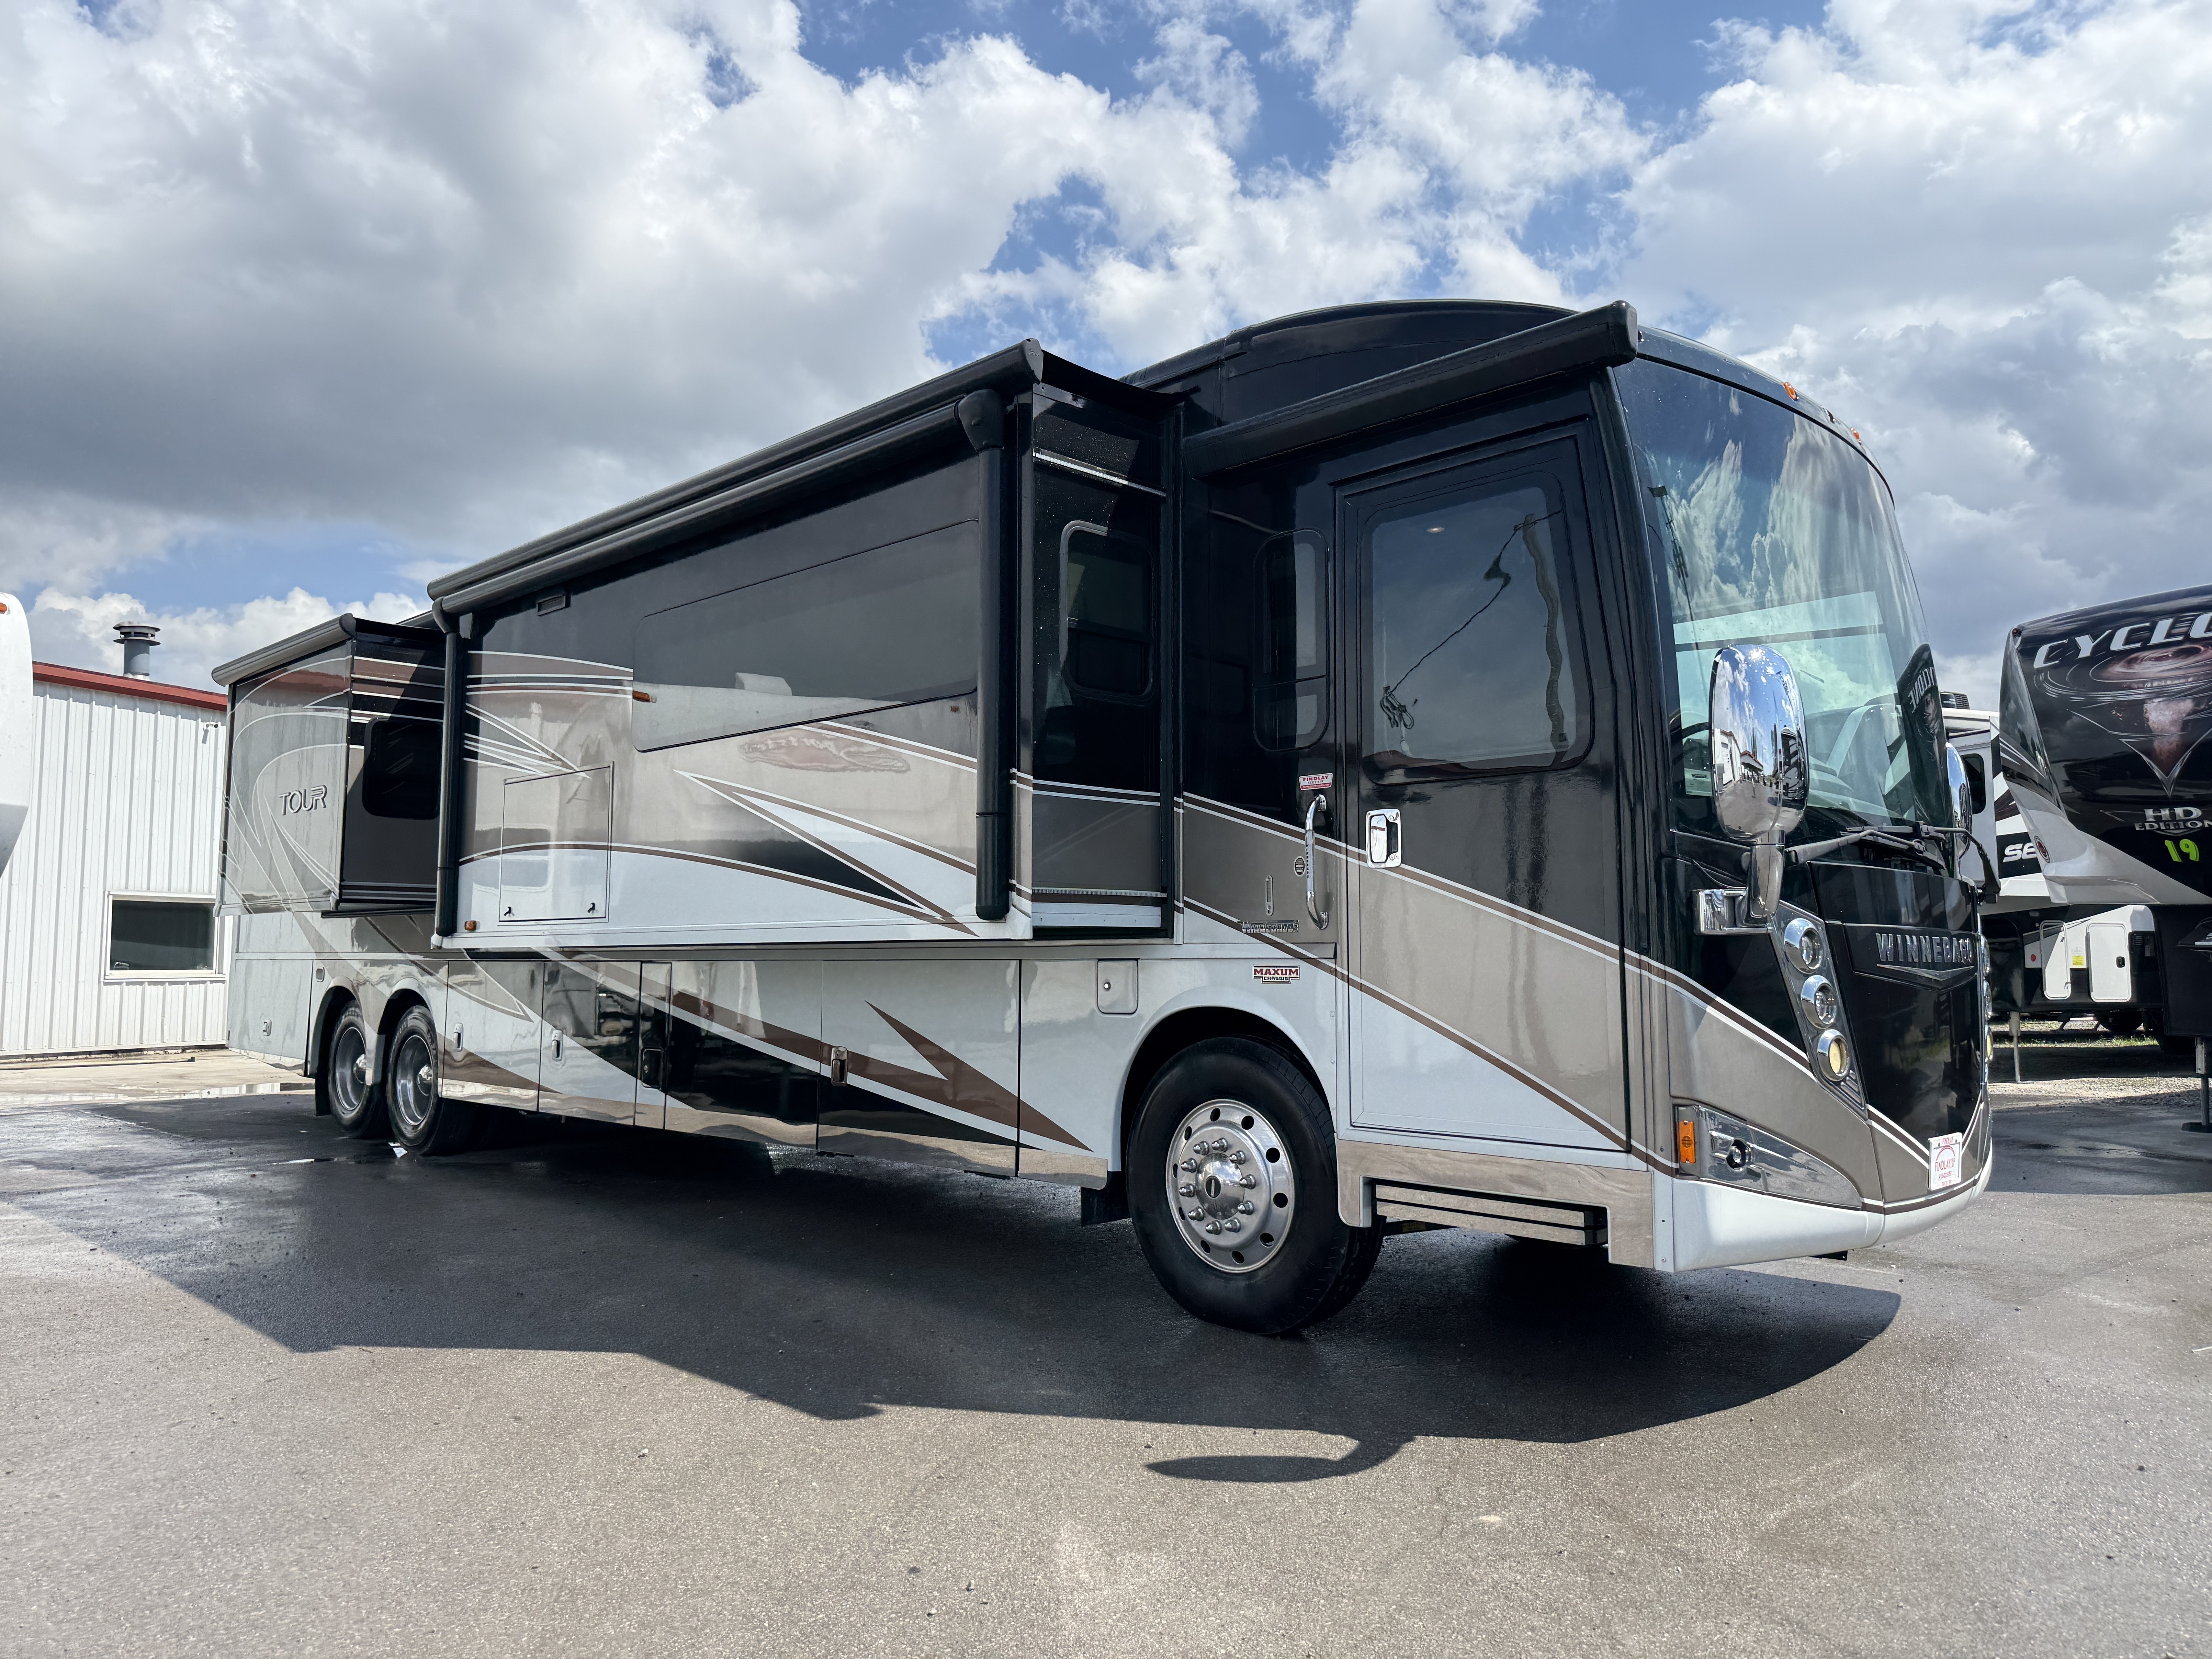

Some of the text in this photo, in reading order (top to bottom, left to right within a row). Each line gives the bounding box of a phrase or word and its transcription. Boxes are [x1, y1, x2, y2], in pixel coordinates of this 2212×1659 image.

[279, 785, 327, 816] TOUR
[2144, 807, 2202, 821] HD
[2165, 839, 2199, 862] 19
[1875, 933, 1972, 964] WINNEBAGO
